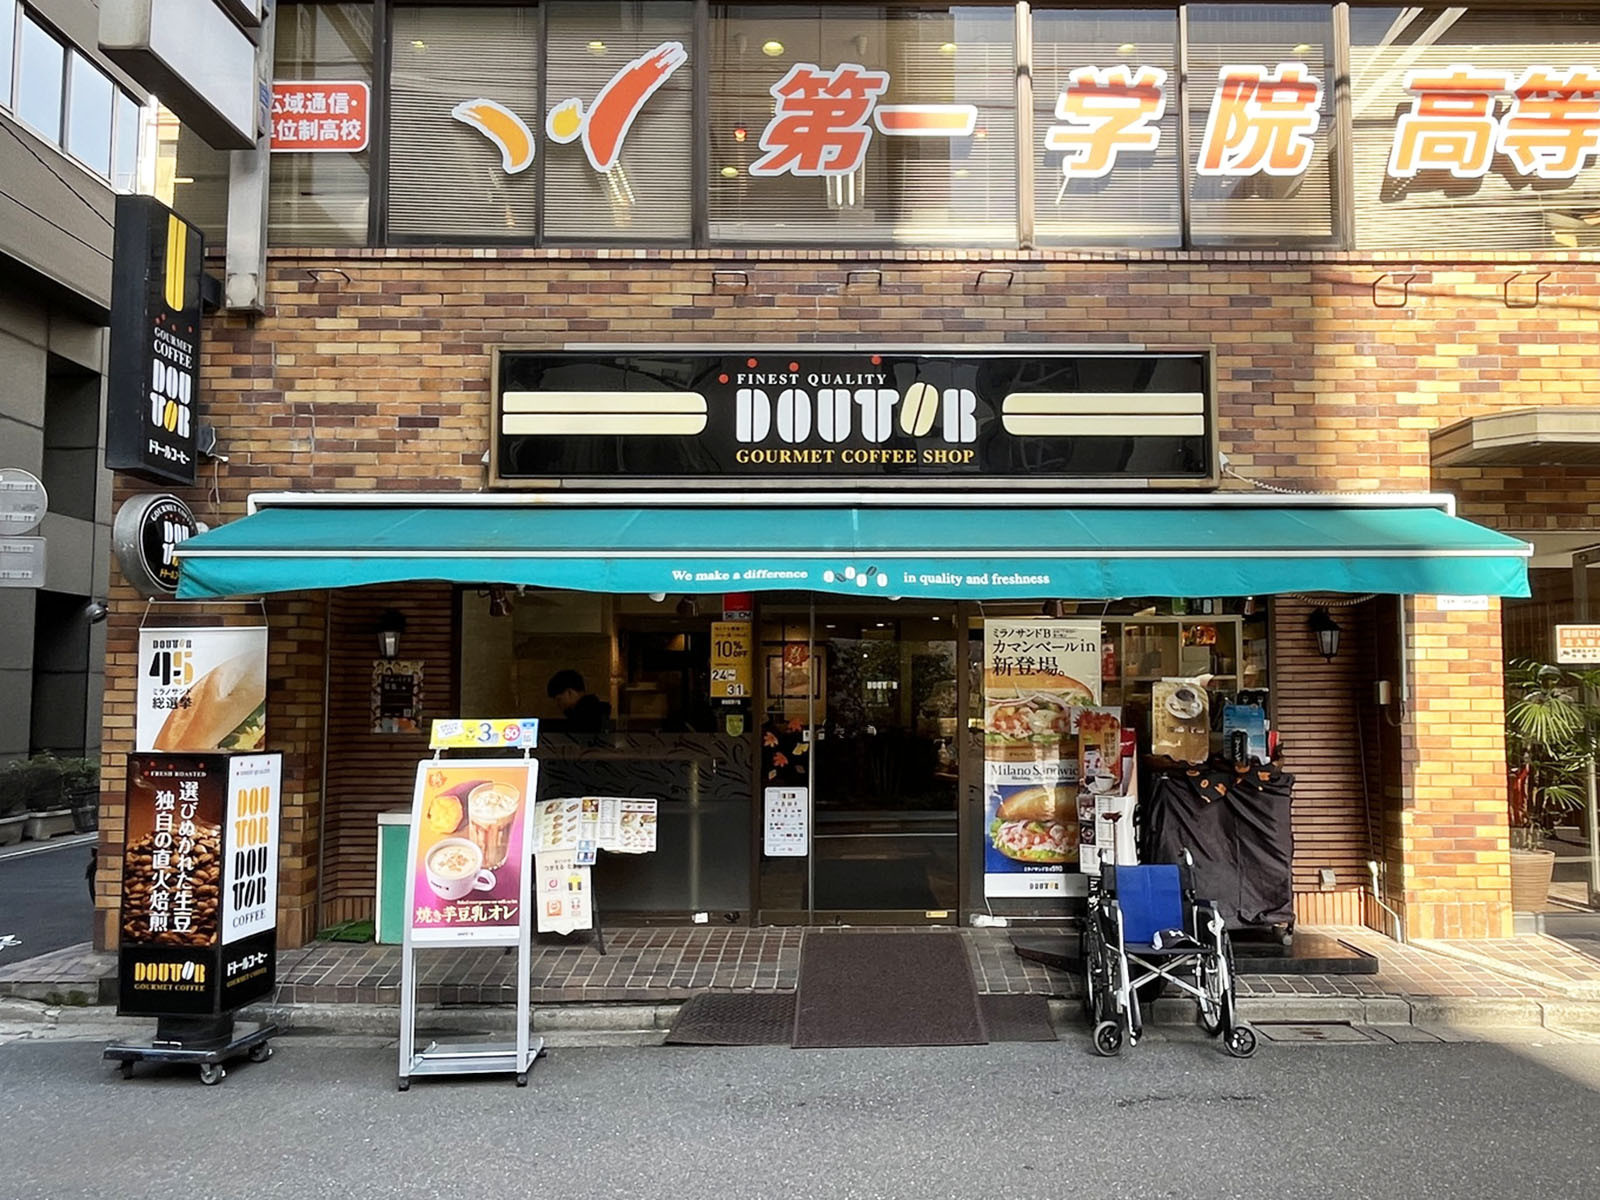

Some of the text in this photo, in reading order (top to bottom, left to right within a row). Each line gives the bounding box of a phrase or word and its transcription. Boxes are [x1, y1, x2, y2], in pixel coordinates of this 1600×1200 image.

[271, 119, 362, 141] 位制高校
[154, 326, 193, 355] GOURMET
[153, 338, 193, 370] COFFEE
[736, 373, 887, 387] FINEST QUALITY
[735, 381, 977, 444] DOUTOR
[148, 438, 191, 465] ドトールコーヒー
[735, 449, 975, 464] GOURMET COFFEE SHOP
[672, 569, 809, 581] We make a difference
[903, 572, 1050, 586] in quality and freshness
[153, 638, 192, 649] DOUTOR
[992, 638, 1097, 654] カマンベールin
[148, 651, 194, 687] 45
[991, 655, 1065, 677] 新登場。
[152, 696, 193, 711] 総選挙
[991, 764, 1031, 777] Milano
[149, 789, 176, 932] 独自の直火焙煎
[172, 780, 200, 933] 選びぬかれた生豆
[232, 908, 267, 928] COFFEE
[415, 904, 519, 924] 焼き芋豆乳オレ
[134, 960, 206, 984] DOUTOR
[134, 983, 206, 992] GOURMET COFFEE
